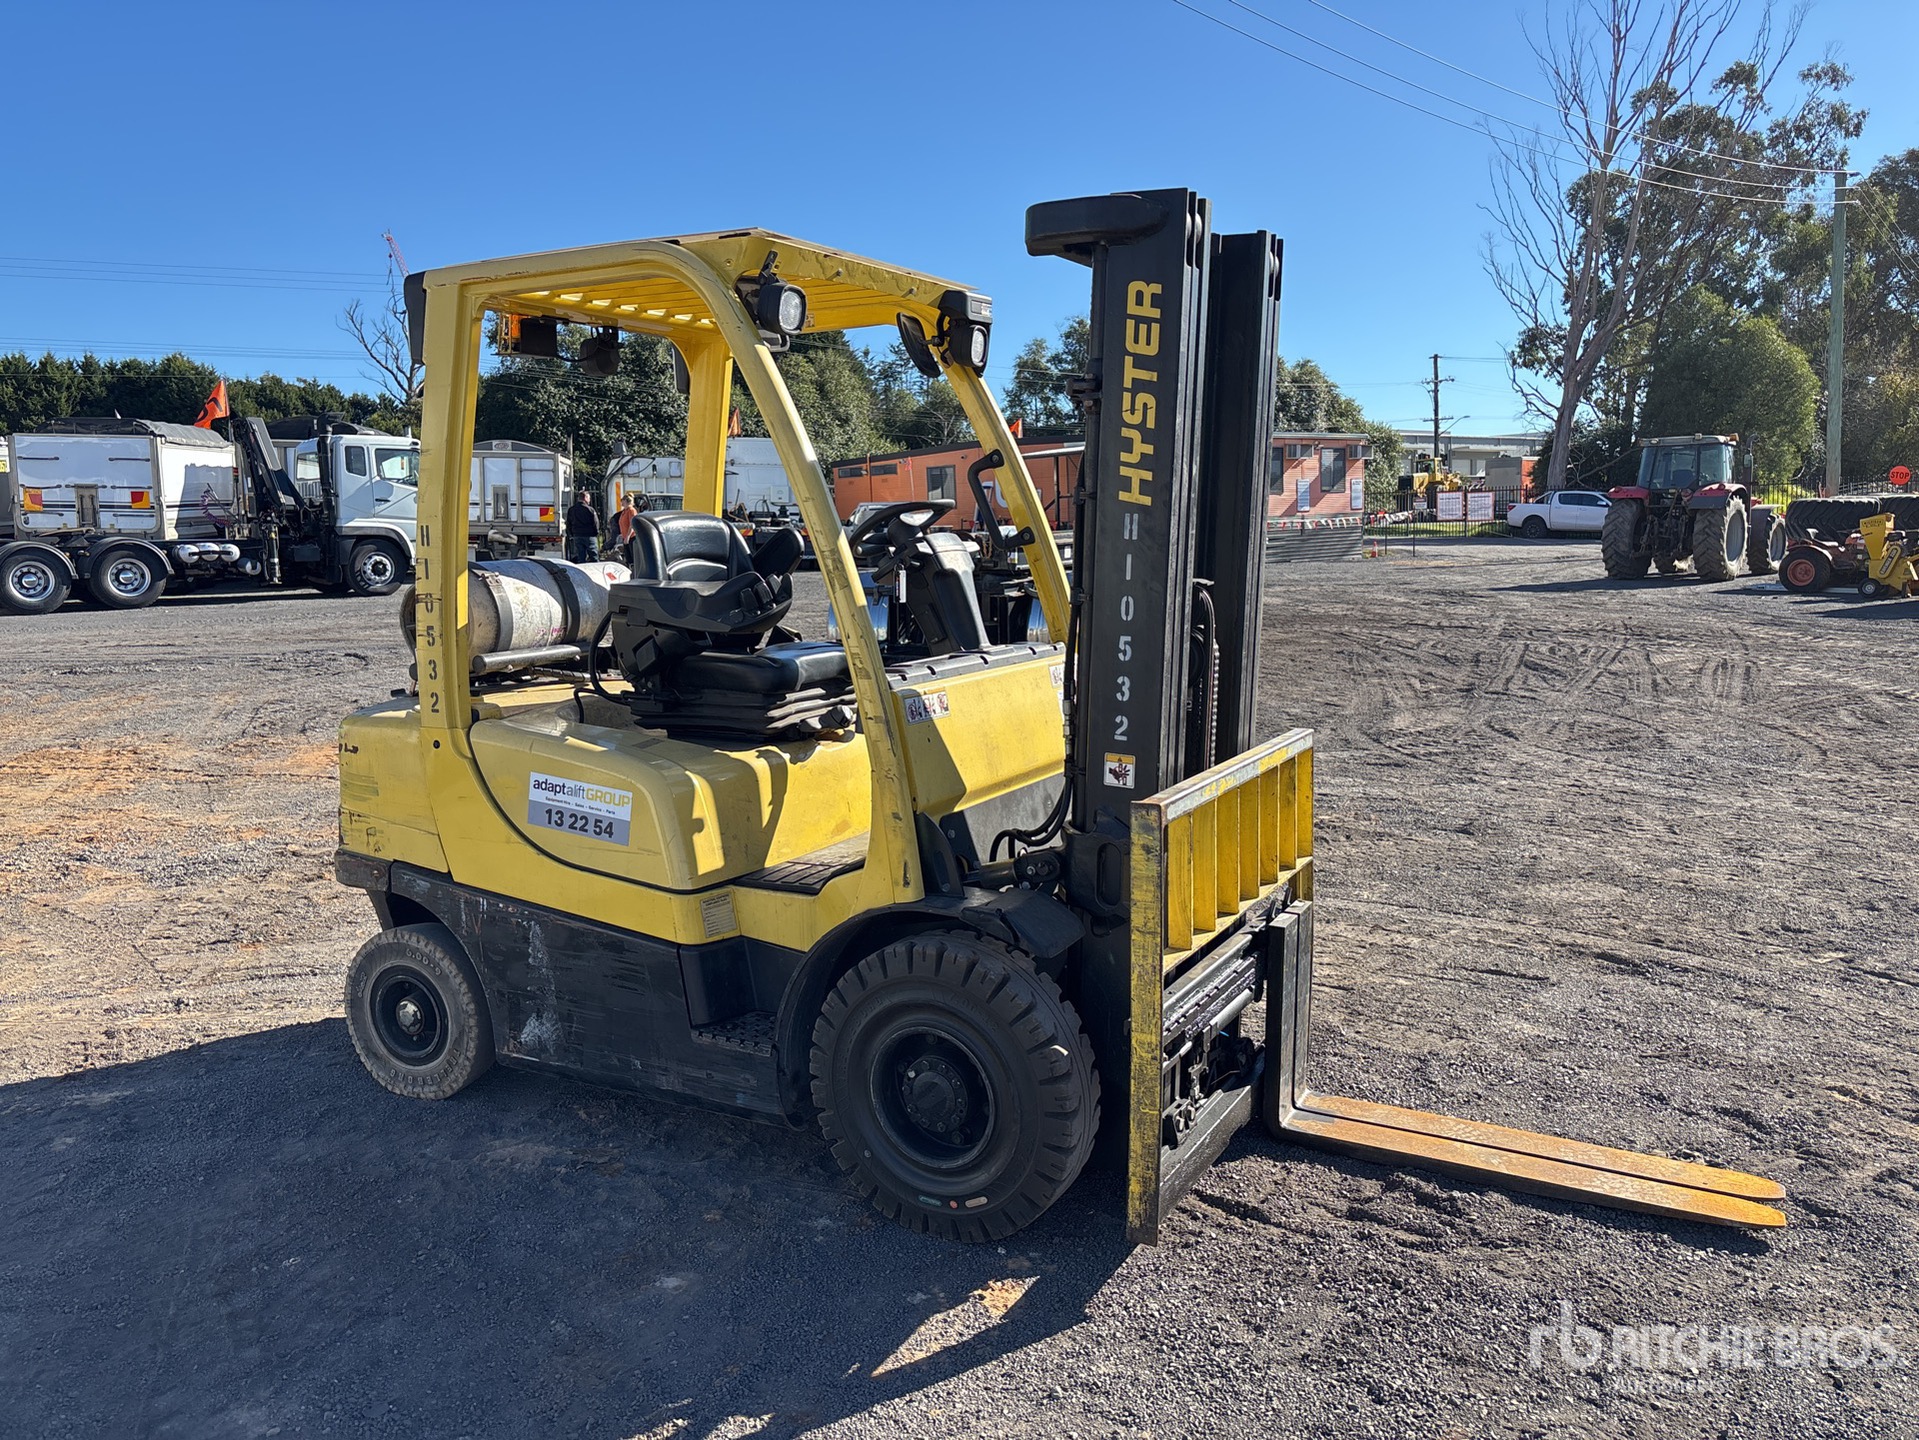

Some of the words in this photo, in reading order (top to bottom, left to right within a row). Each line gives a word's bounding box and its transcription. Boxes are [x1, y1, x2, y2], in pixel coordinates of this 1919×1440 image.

[1118, 280, 1163, 507] HYSTER
[1890, 471, 1910, 480] STOP
[533, 779, 631, 807] adaptaliftGROUP
[545, 808, 565, 828] 13
[568, 812, 589, 833] 22
[593, 818, 614, 838] 54
[389, 1048, 462, 1086] TRELLEBORG
